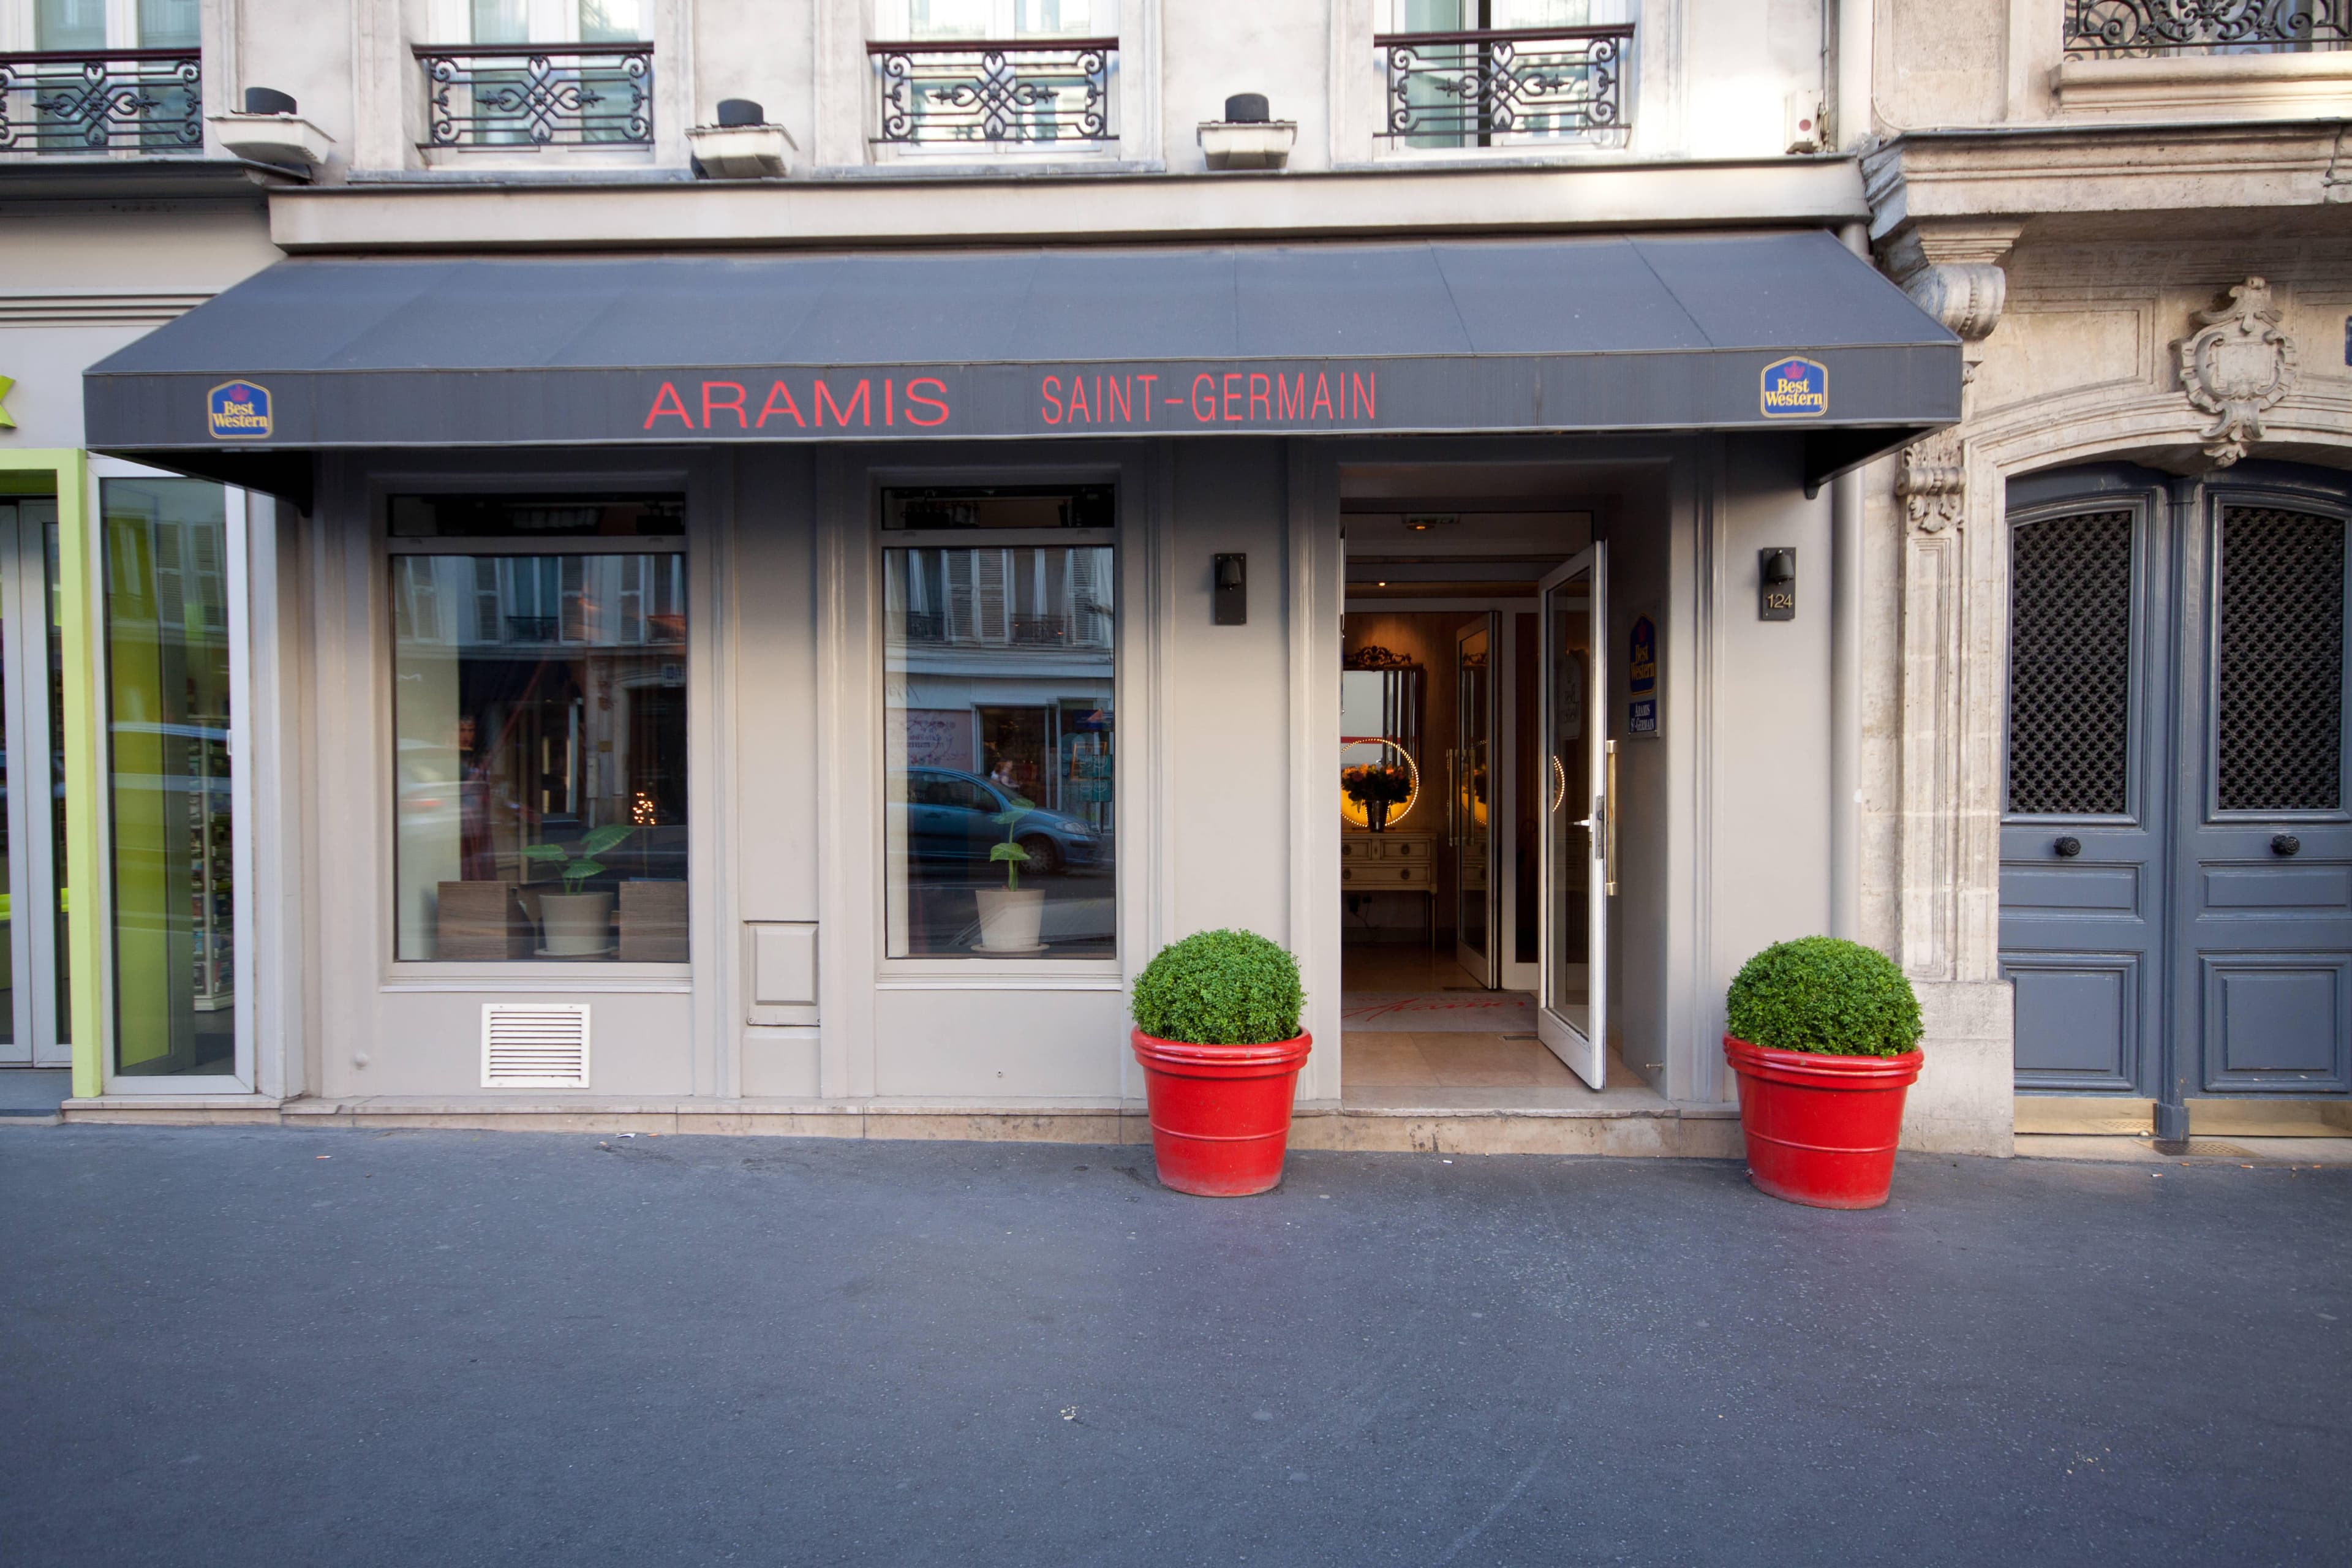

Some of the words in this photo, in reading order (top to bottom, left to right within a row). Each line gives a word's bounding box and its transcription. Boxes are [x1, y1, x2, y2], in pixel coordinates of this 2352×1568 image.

[1777, 378, 1809, 393] Best
[643, 377, 949, 430] ARAMIS
[1041, 372, 1375, 425] SAINT-GERMAIN
[1765, 391, 1823, 407] Western
[223, 401, 254, 415] Best
[212, 413, 268, 428] Western
[1767, 594, 1793, 608] 124
[1635, 644, 1649, 662] Best
[1630, 662, 1654, 681] Western
